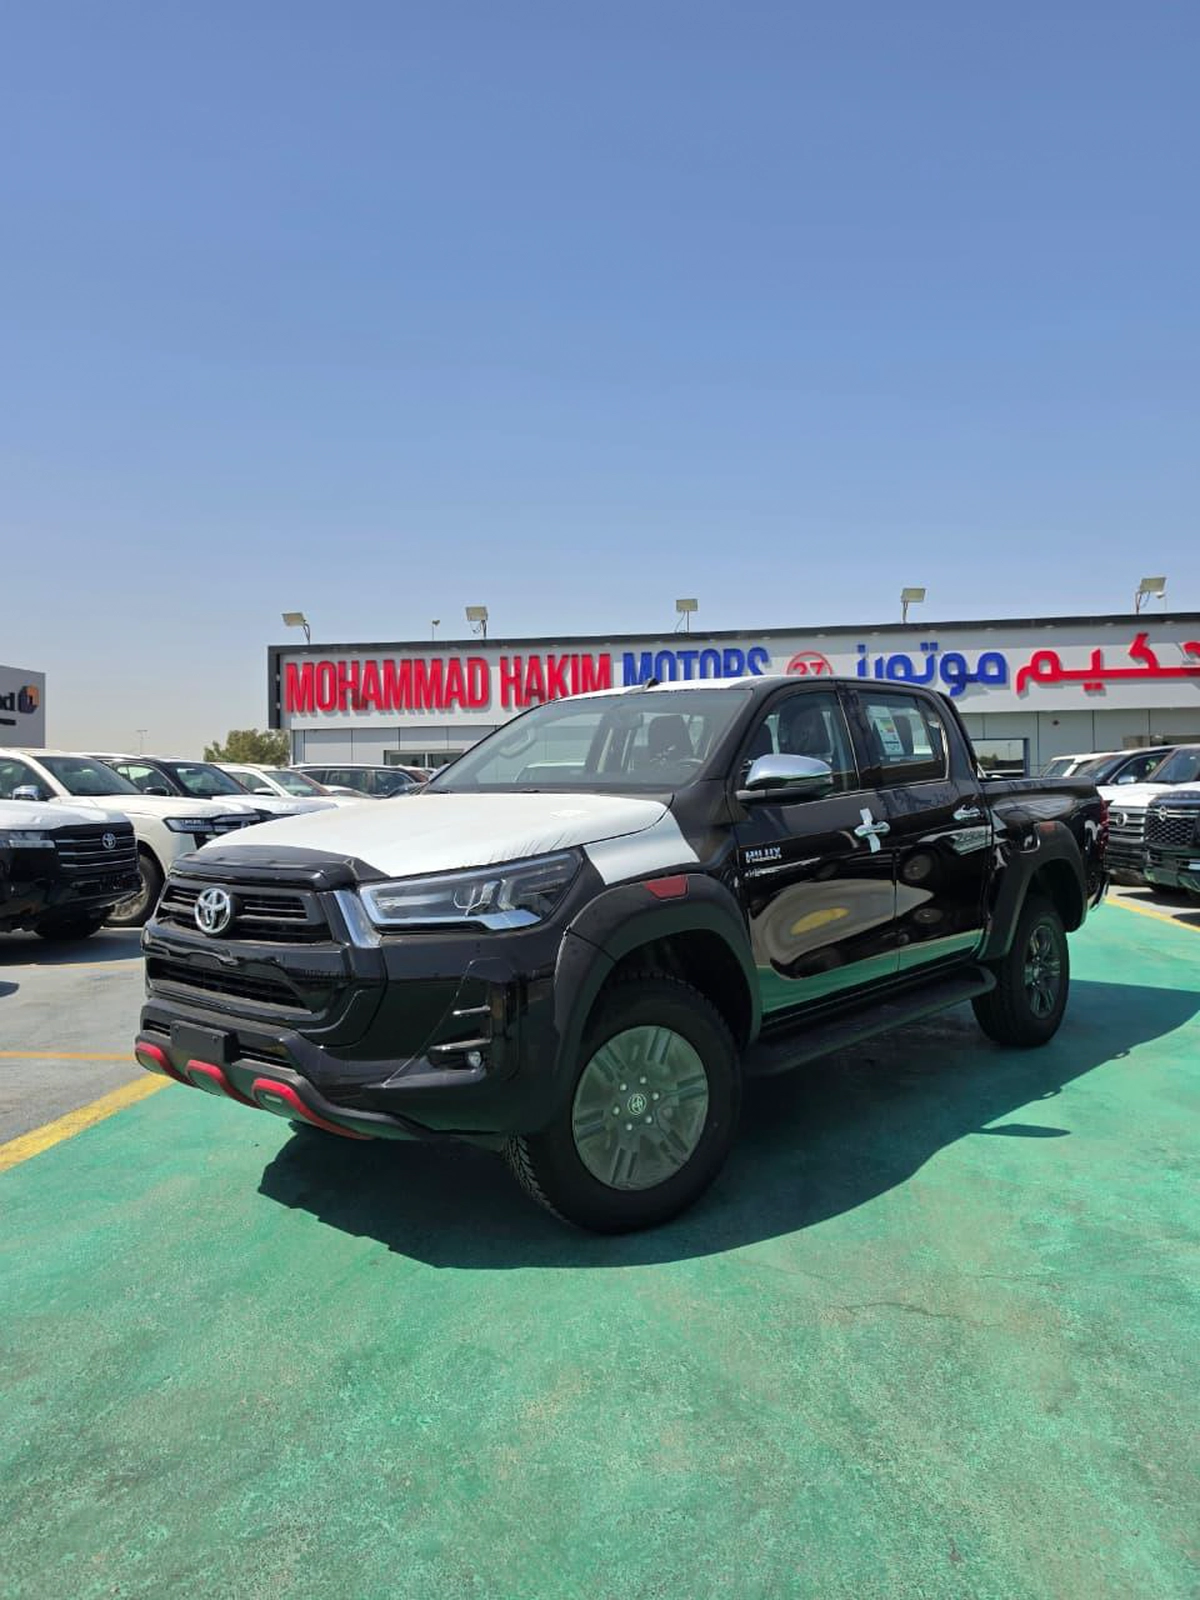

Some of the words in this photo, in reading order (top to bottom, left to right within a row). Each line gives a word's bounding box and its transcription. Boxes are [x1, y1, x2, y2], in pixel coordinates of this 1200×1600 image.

[285, 657, 490, 712] MOHAMMAD
[500, 652, 611, 708] HAKIM
[623, 647, 769, 687] MOTORS
